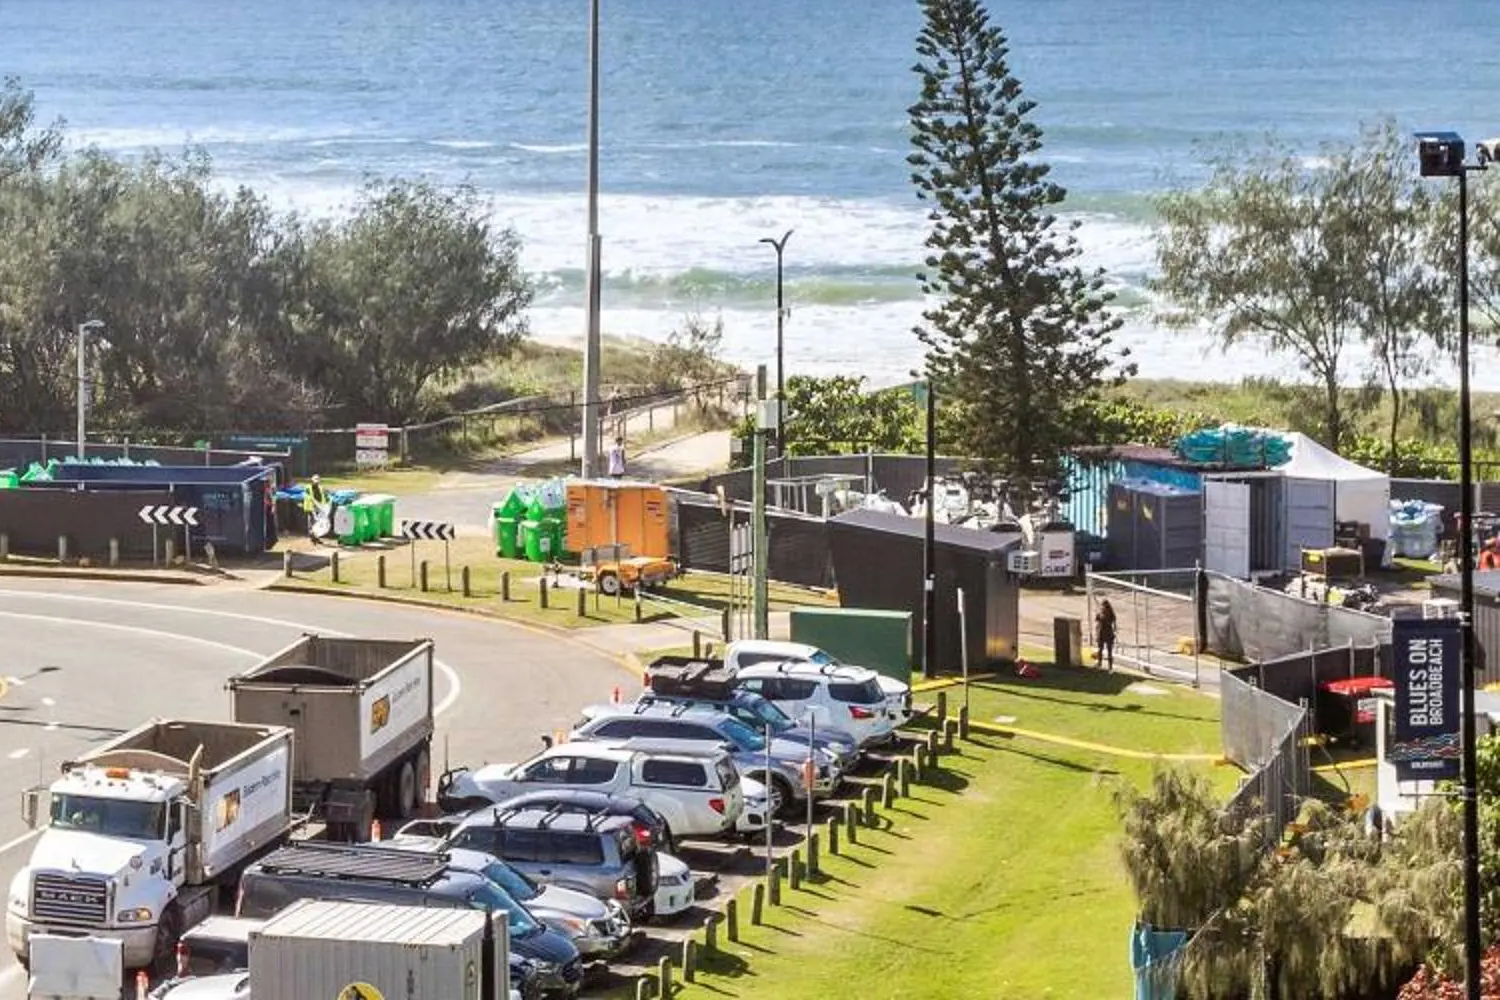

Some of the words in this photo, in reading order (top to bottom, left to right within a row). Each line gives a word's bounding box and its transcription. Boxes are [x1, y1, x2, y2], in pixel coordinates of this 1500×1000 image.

[1409, 639, 1428, 664] ON
[1409, 669, 1428, 725] BLUES
[1428, 639, 1443, 725] BROADBEACH
